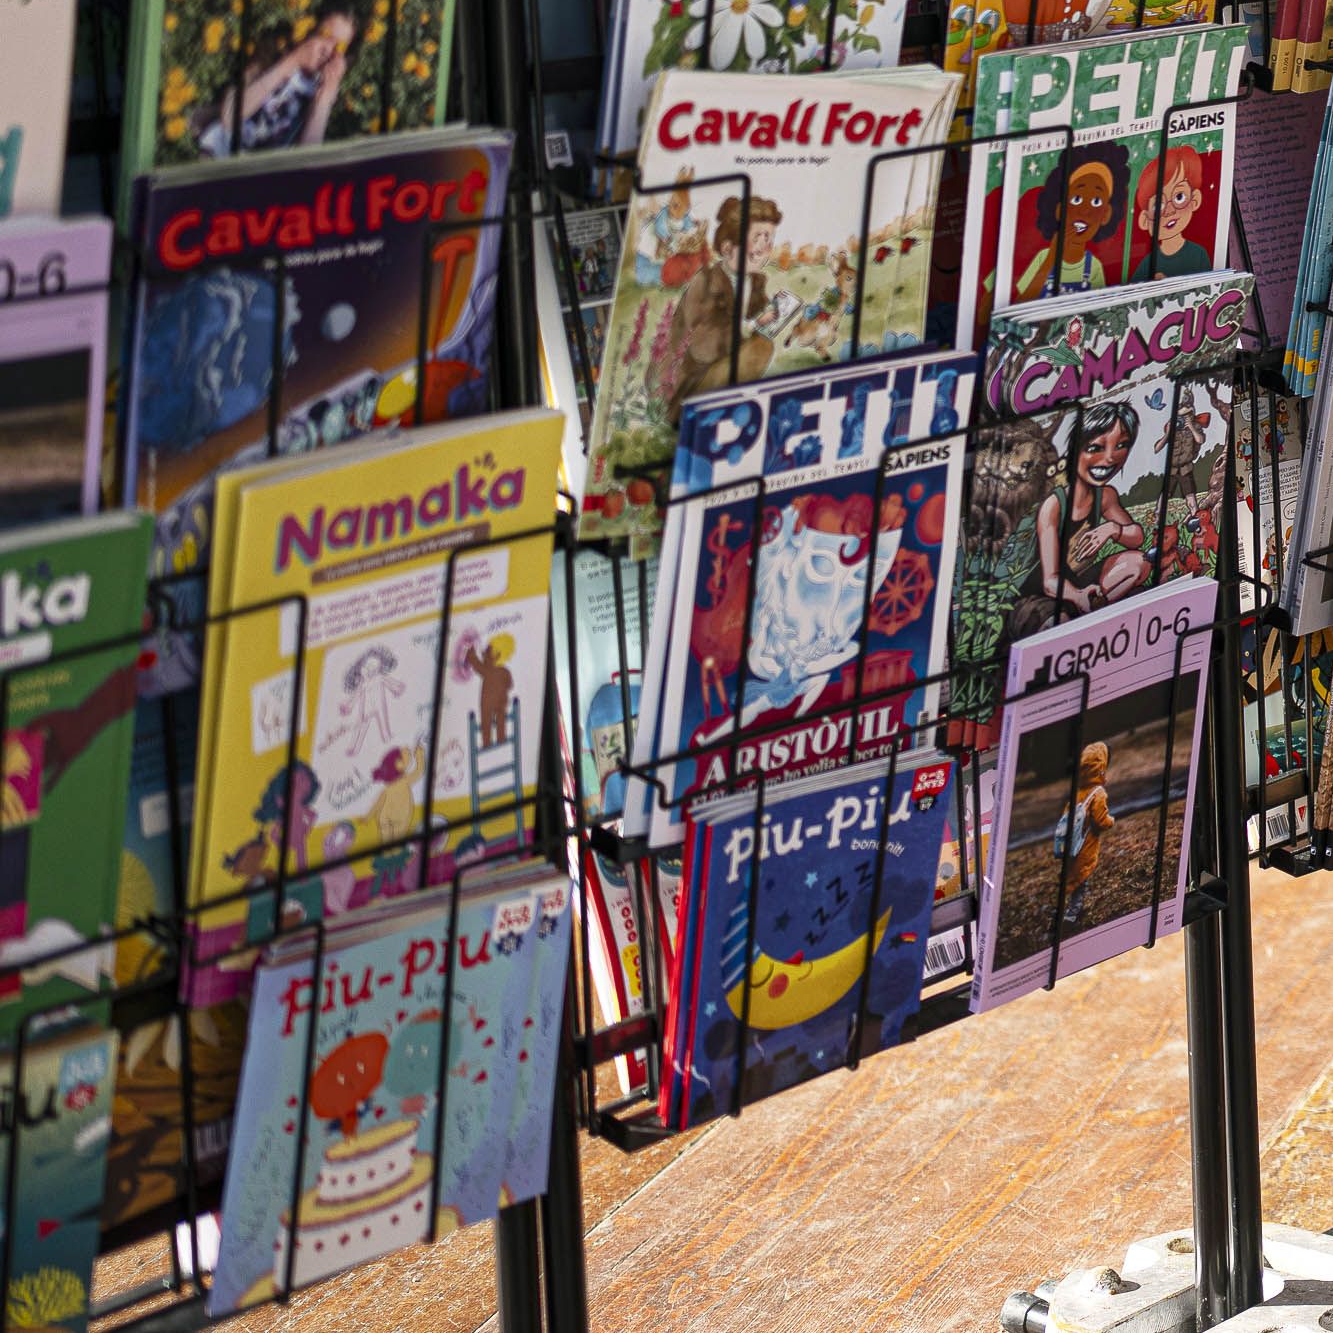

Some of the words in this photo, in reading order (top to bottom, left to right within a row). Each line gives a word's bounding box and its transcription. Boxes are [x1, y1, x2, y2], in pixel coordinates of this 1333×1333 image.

[657, 99, 819, 151] Cavall
[821, 103, 923, 147] Fort
[1013, 27, 1250, 139] PETIT
[1169, 110, 1226, 134] SÀPIENS
[159, 182, 354, 271] Cavall
[366, 168, 487, 231] Fort
[1014, 289, 1247, 415] CAMACUC
[692, 353, 977, 492] PETIT
[277, 466, 525, 572] Namaka
[1052, 623, 1130, 681] GRAÓ
[1145, 607, 1191, 645] 0-6
[803, 758, 835, 777] volia
